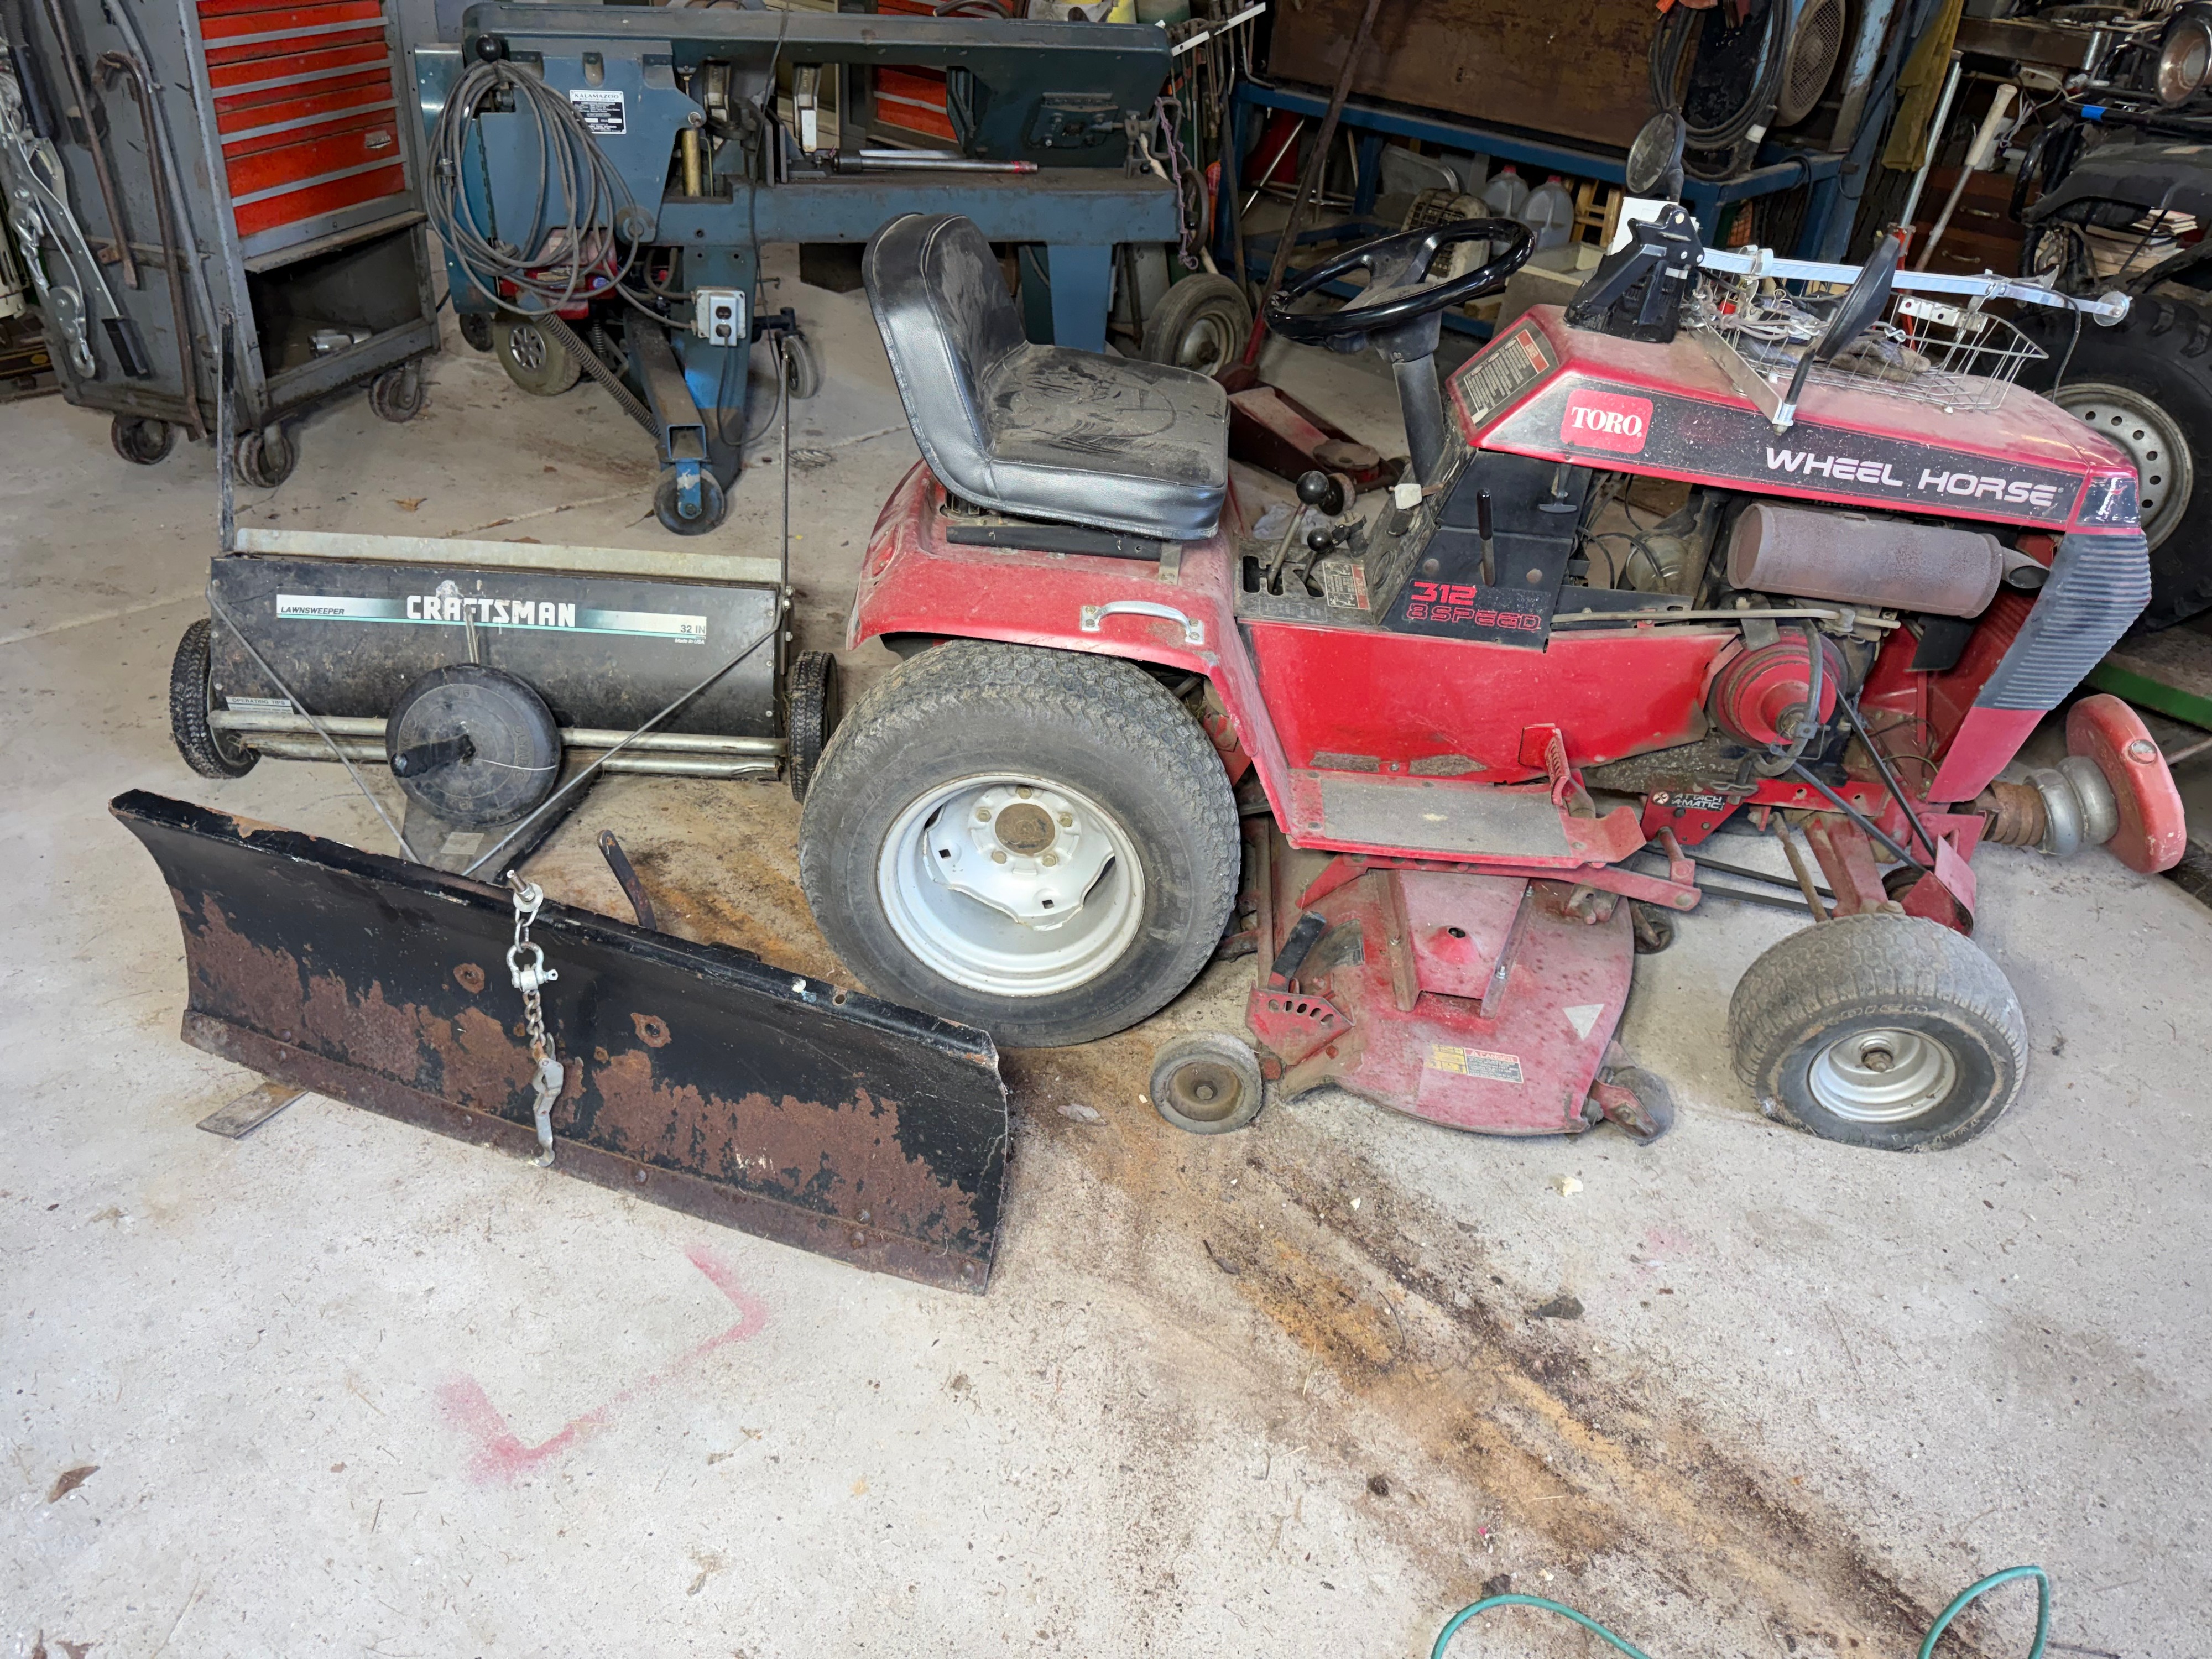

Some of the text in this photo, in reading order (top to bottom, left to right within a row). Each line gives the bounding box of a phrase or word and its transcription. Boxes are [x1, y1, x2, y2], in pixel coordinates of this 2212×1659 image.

[1571, 406, 1642, 436] TORO
[1766, 447, 2057, 507] WHEEL HORSE
[1411, 581, 1477, 606] 312
[281, 607, 345, 615] LAWNSWEEPER
[406, 595, 576, 627] CRAFTSMAN
[1407, 603, 1541, 630] 8 SPEED
[696, 625, 706, 634] IN
[514, 724, 530, 779] OLYMPC
[1674, 793, 1722, 802] ATTACH
